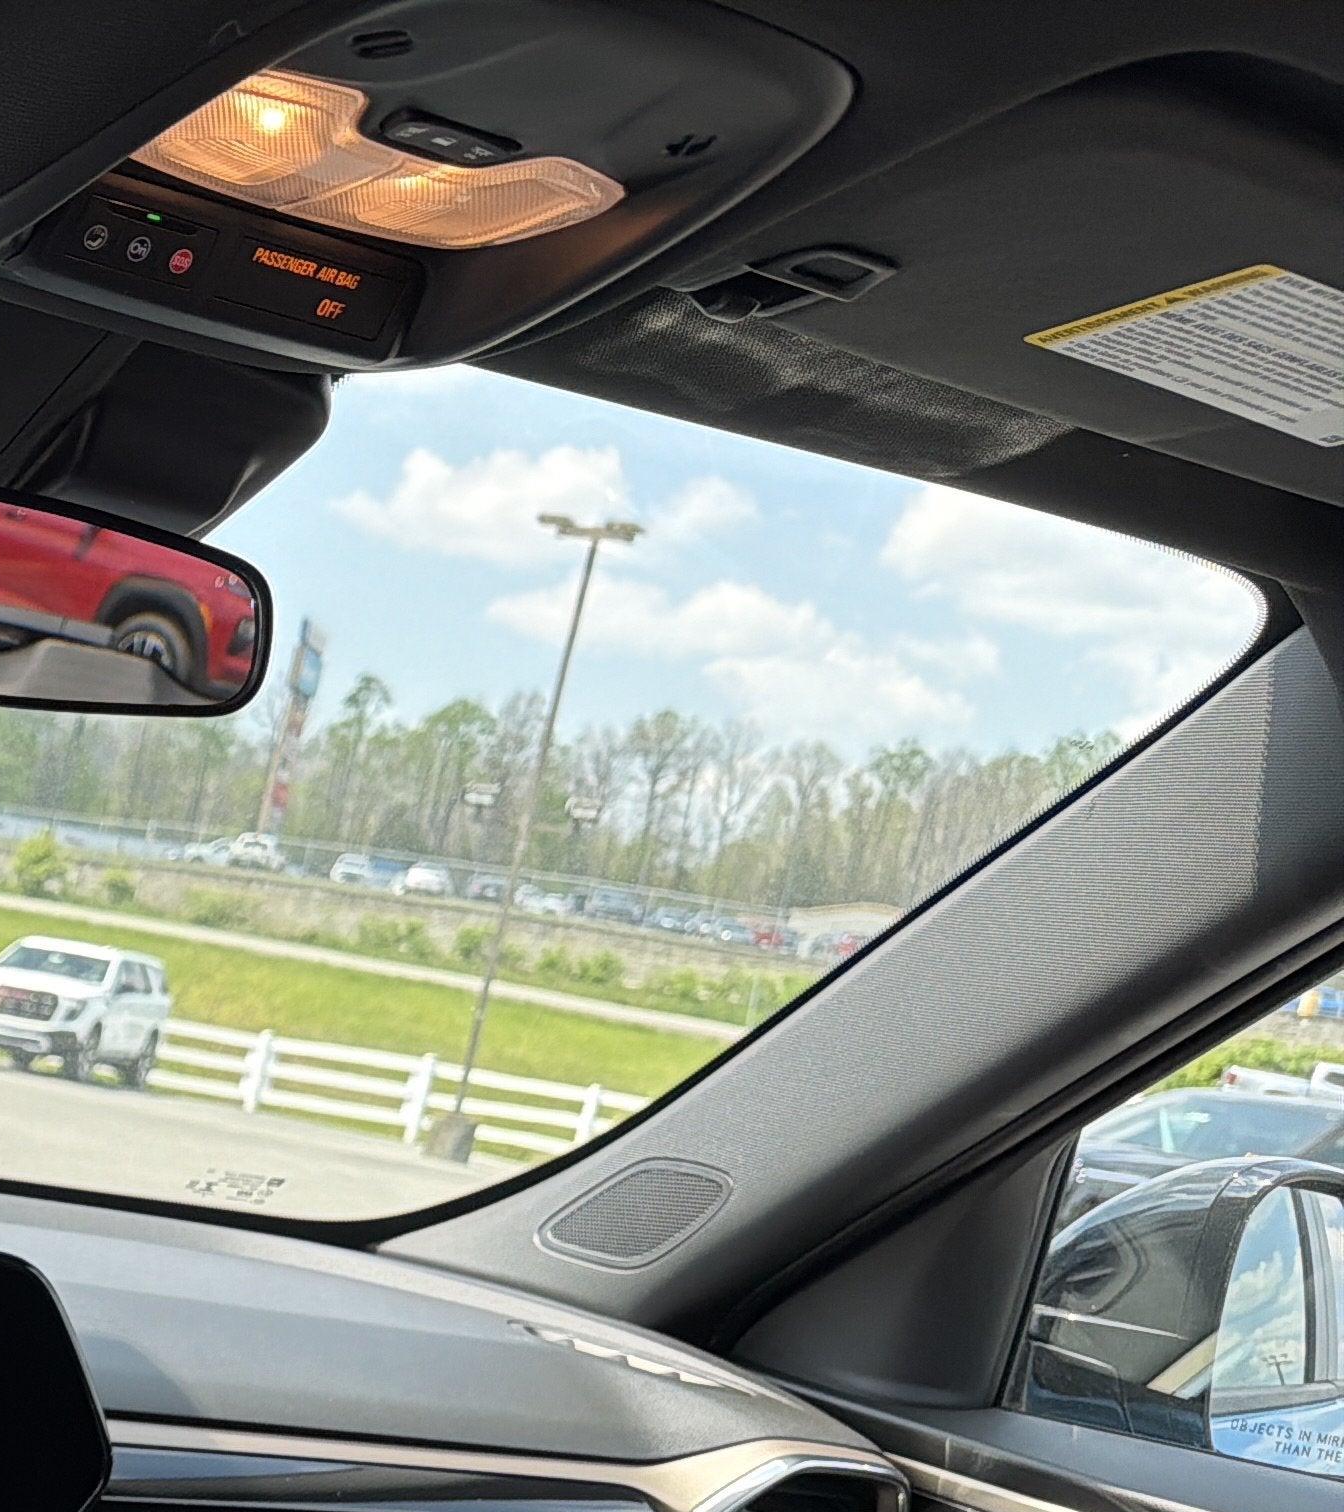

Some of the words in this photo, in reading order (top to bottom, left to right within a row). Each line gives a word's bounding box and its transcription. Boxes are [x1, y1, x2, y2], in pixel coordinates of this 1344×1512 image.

[172, 252, 193, 270] SOS
[253, 247, 317, 277] PASSENGER
[316, 265, 337, 283] AIR
[336, 272, 361, 290] BAG
[316, 299, 347, 319] OFF
[1230, 1418, 1293, 1440] OBJECTS
[1298, 1429, 1312, 1442] IN
[1275, 1441, 1312, 1457] THAN
